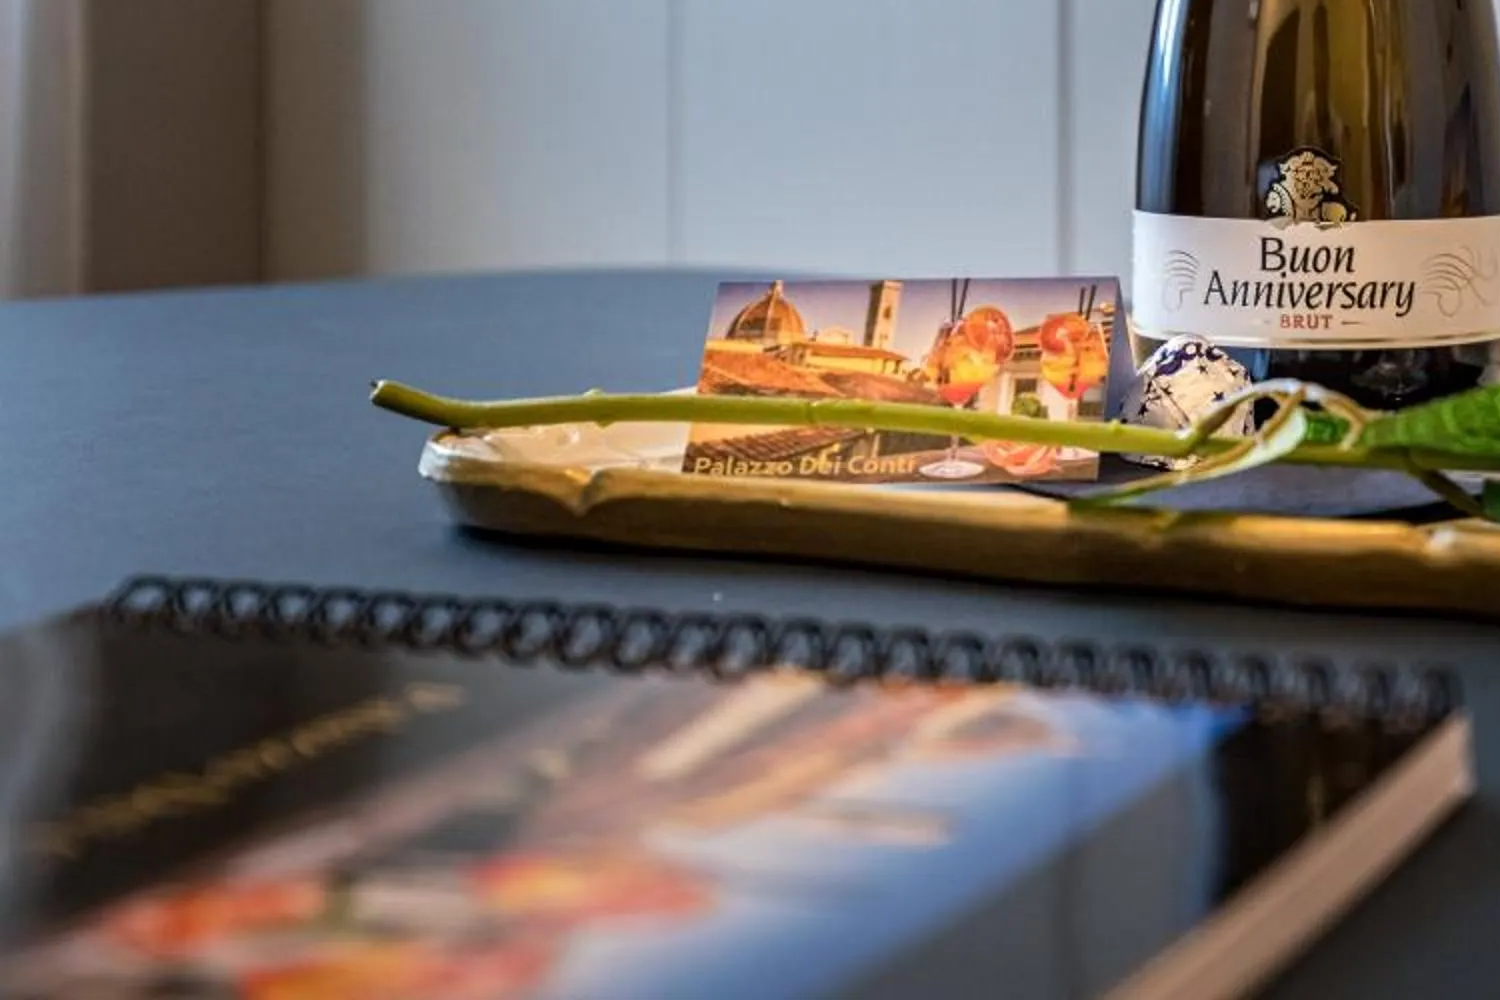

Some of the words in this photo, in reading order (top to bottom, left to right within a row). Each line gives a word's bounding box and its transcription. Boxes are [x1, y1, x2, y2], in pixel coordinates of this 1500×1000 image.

[1261, 236, 1355, 273] Buon
[1203, 269, 1416, 317] Anniversary
[1279, 313, 1334, 329] BRUT
[694, 455, 793, 475] Palazzo
[799, 455, 840, 475] Dei
[847, 456, 916, 475] Conti
